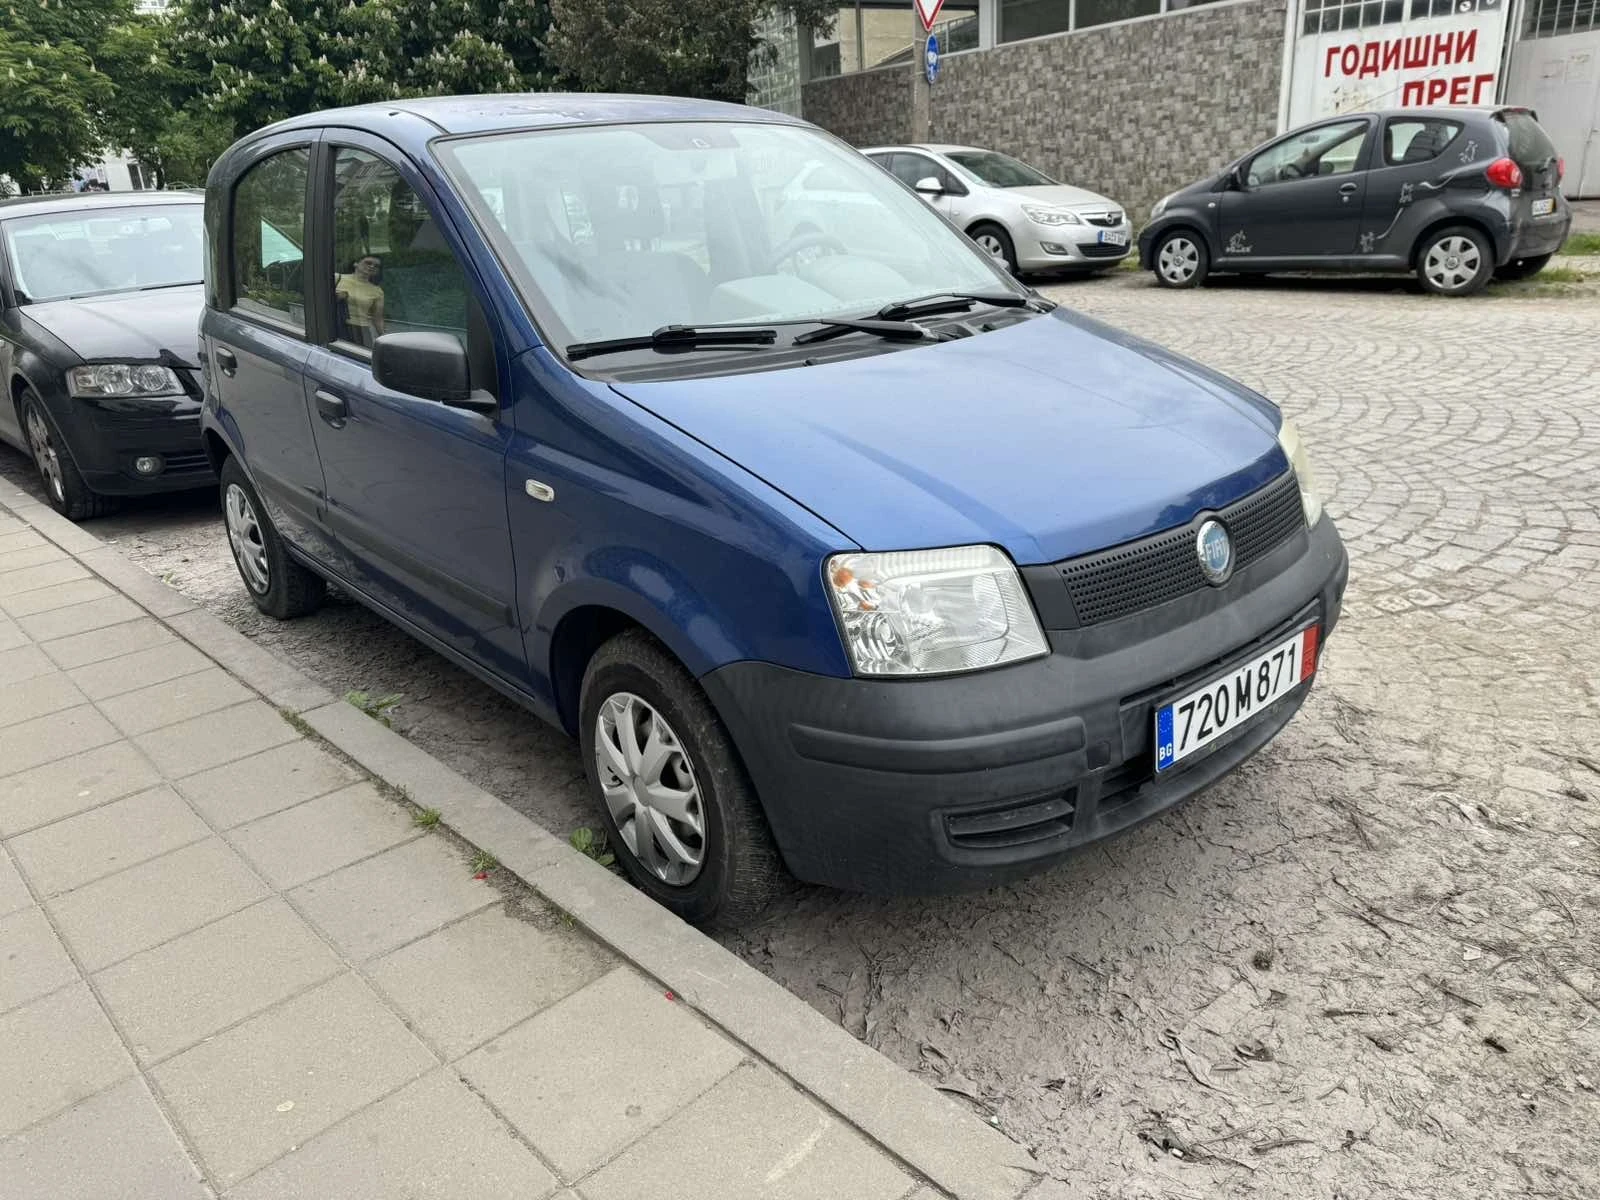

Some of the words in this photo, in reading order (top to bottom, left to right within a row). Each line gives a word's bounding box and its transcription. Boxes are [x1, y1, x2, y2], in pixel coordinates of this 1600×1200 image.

[1325, 29, 1478, 79] ГОДИШНИ
[1402, 74, 1494, 106] ПРЕГ
[1204, 536, 1228, 562] FIAT
[1159, 743, 1172, 761] BG
